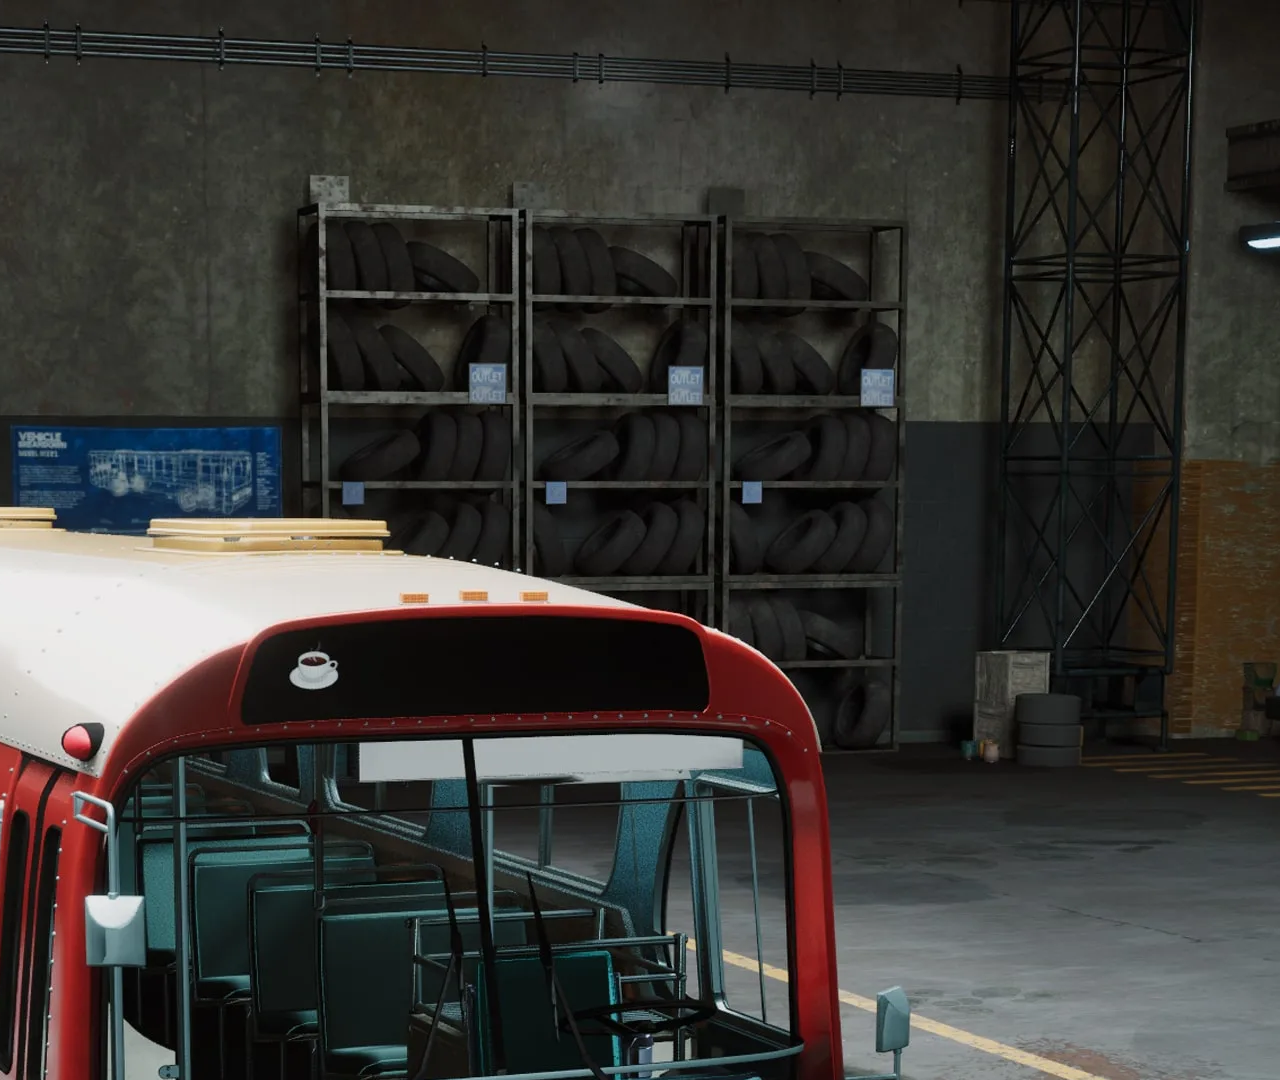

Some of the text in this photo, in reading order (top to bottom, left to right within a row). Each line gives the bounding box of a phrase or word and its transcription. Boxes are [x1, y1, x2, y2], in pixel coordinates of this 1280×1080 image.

[670, 374, 700, 385] OUTLET
[863, 375, 891, 386] OUTLET
[18, 431, 62, 441] VEHICLE
